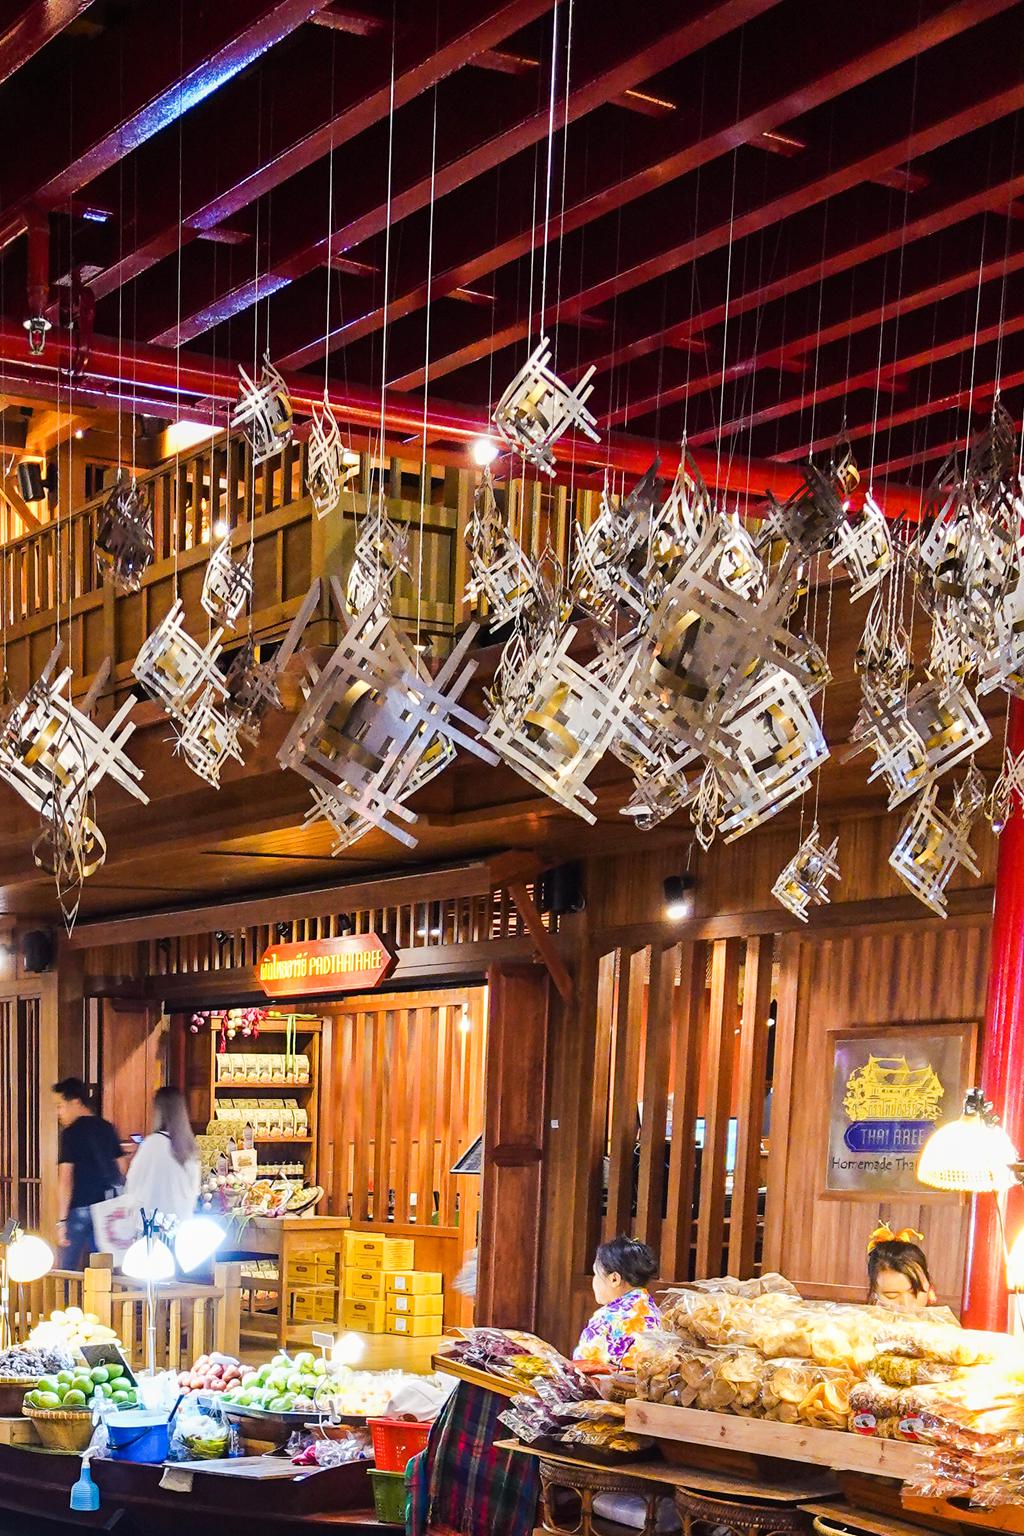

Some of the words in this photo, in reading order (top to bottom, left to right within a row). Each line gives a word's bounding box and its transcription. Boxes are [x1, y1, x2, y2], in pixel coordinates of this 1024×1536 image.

[355, 949, 381, 971] AREE
[860, 1128, 888, 1145] THAI
[893, 1128, 925, 1145] AREE
[832, 1156, 893, 1170] Homemade
